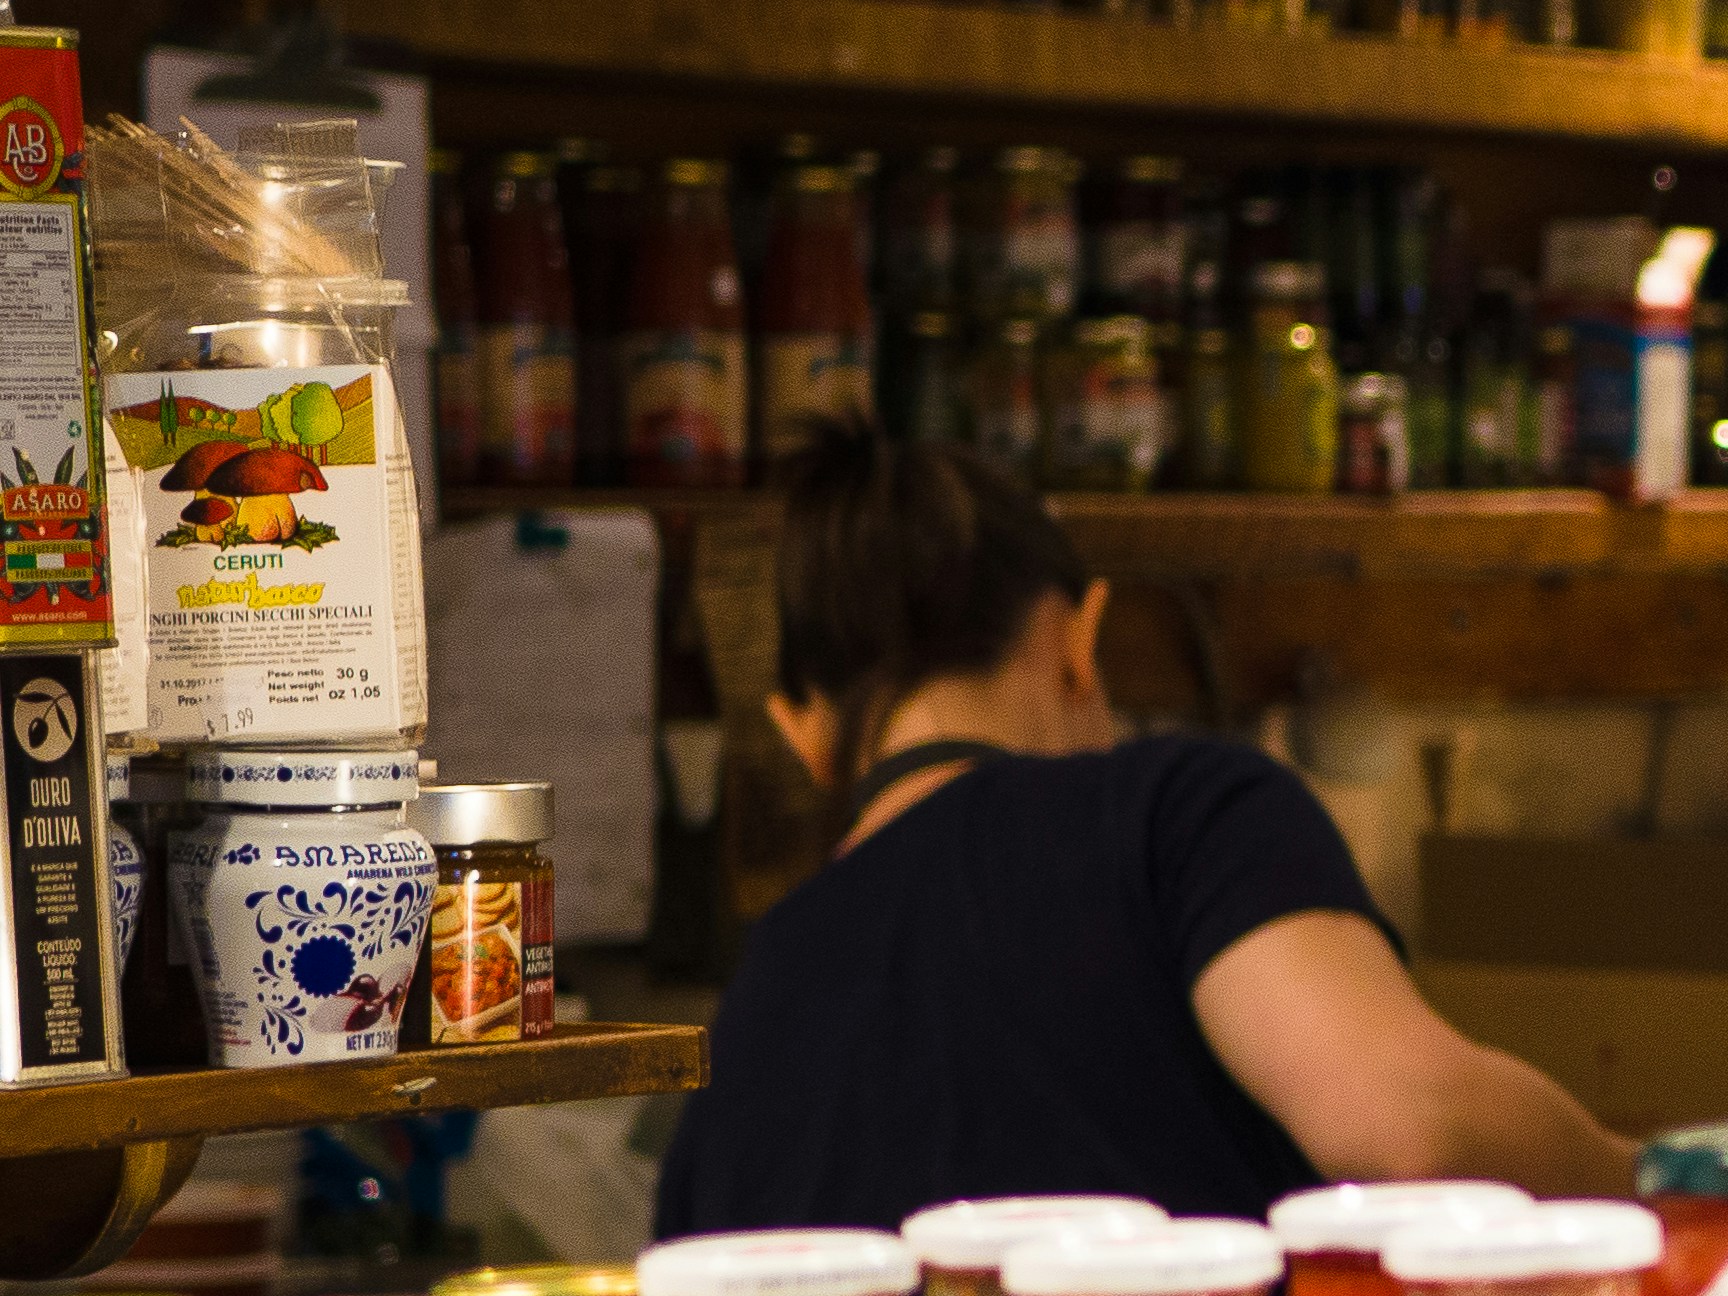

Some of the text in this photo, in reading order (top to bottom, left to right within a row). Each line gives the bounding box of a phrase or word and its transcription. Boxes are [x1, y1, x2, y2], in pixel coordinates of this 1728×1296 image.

[0, 215, 34, 225] utrition
[12, 489, 82, 514] ASARO
[213, 553, 284, 571] CERUTI
[150, 605, 372, 627] NGHI PORCINI SECCHI SPECIALI
[336, 667, 369, 682] 30 g
[268, 680, 325, 692] Net weight
[351, 685, 381, 701] 1,05
[30, 776, 71, 807] OURO
[23, 816, 82, 848] D'OLIVA
